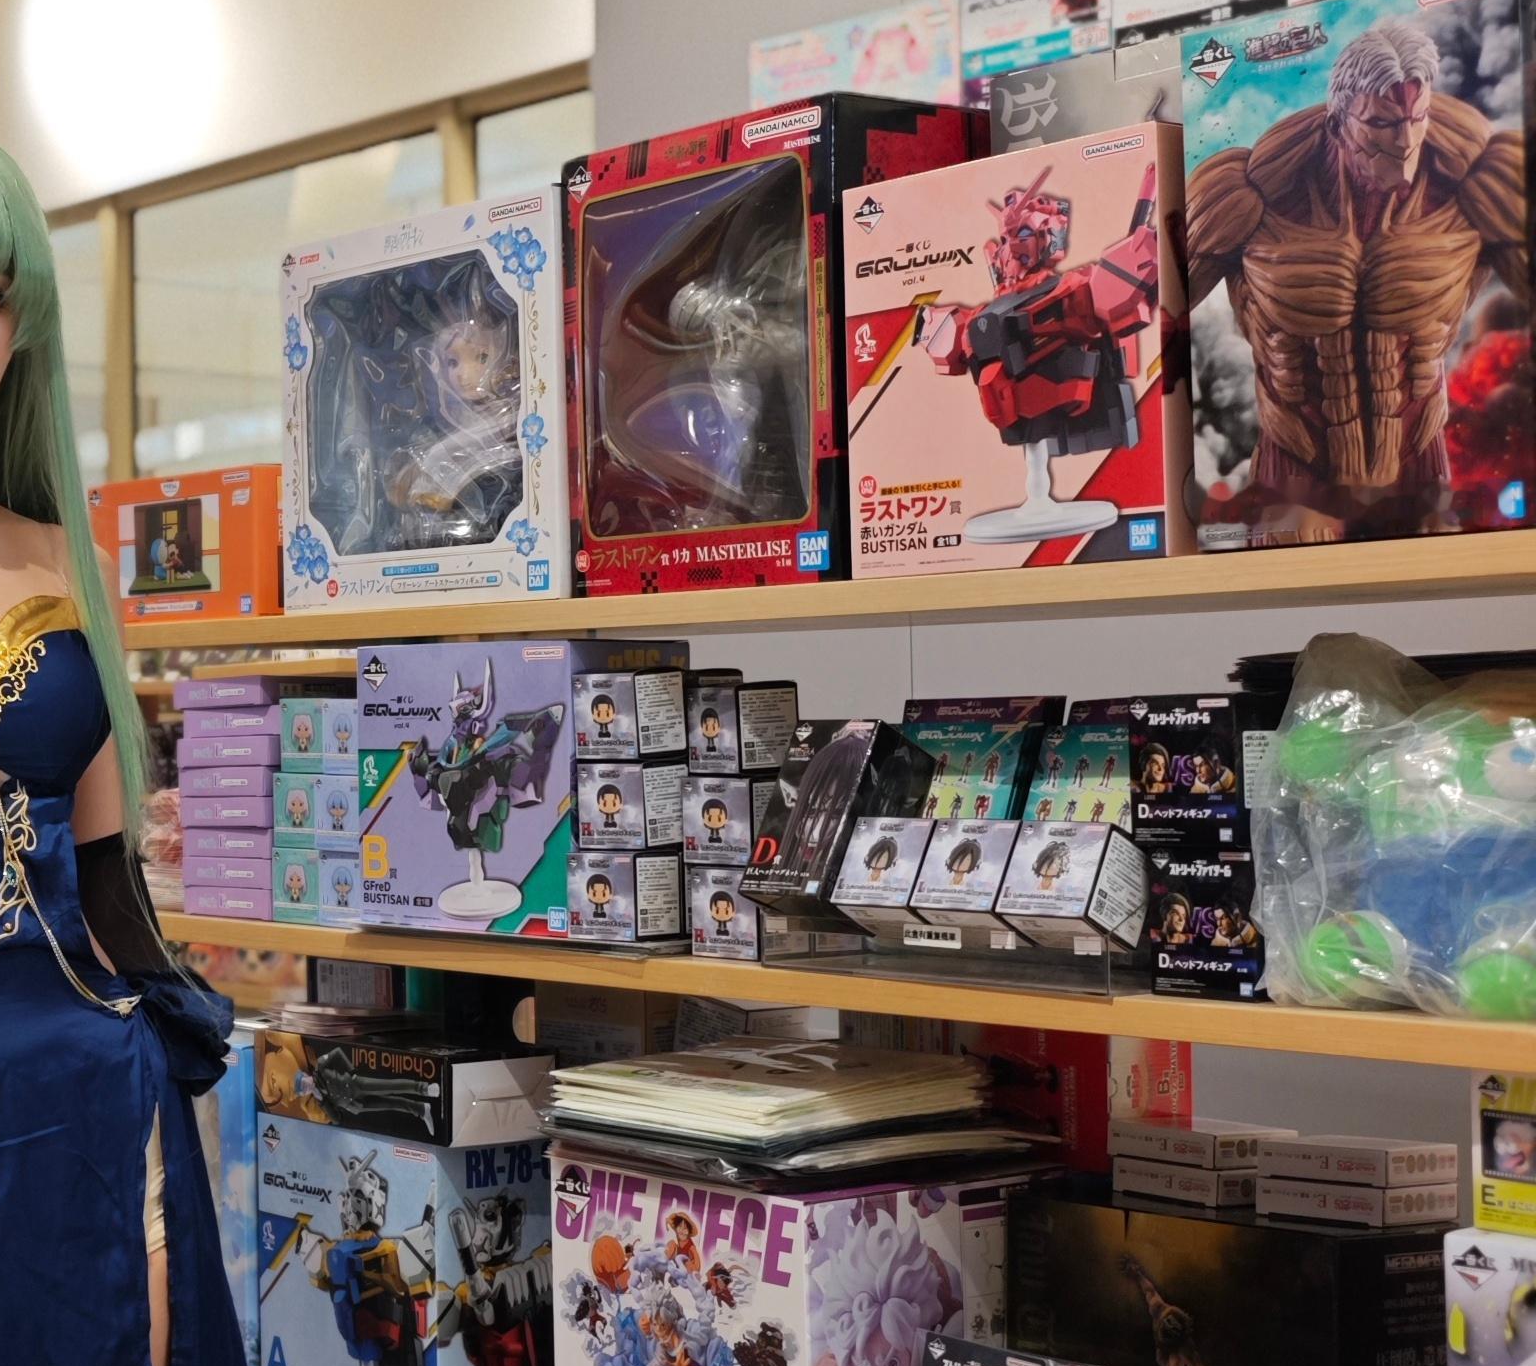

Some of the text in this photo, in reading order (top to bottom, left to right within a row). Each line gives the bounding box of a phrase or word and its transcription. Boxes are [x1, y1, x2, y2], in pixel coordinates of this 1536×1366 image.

[747, 114, 816, 138] BANDAI NAMCO
[1085, 137, 1143, 157] BANDAI NAMCO
[860, 522, 928, 541] 赤いガンダム
[696, 540, 792, 563] MASTERLISE
[860, 537, 927, 555] BUSTISAN
[363, 880, 391, 893] GFreD
[363, 893, 410, 906] BUSTISAN
[351, 1046, 436, 1081] Challia Bull
[655, 1182, 799, 1288] PIECE
